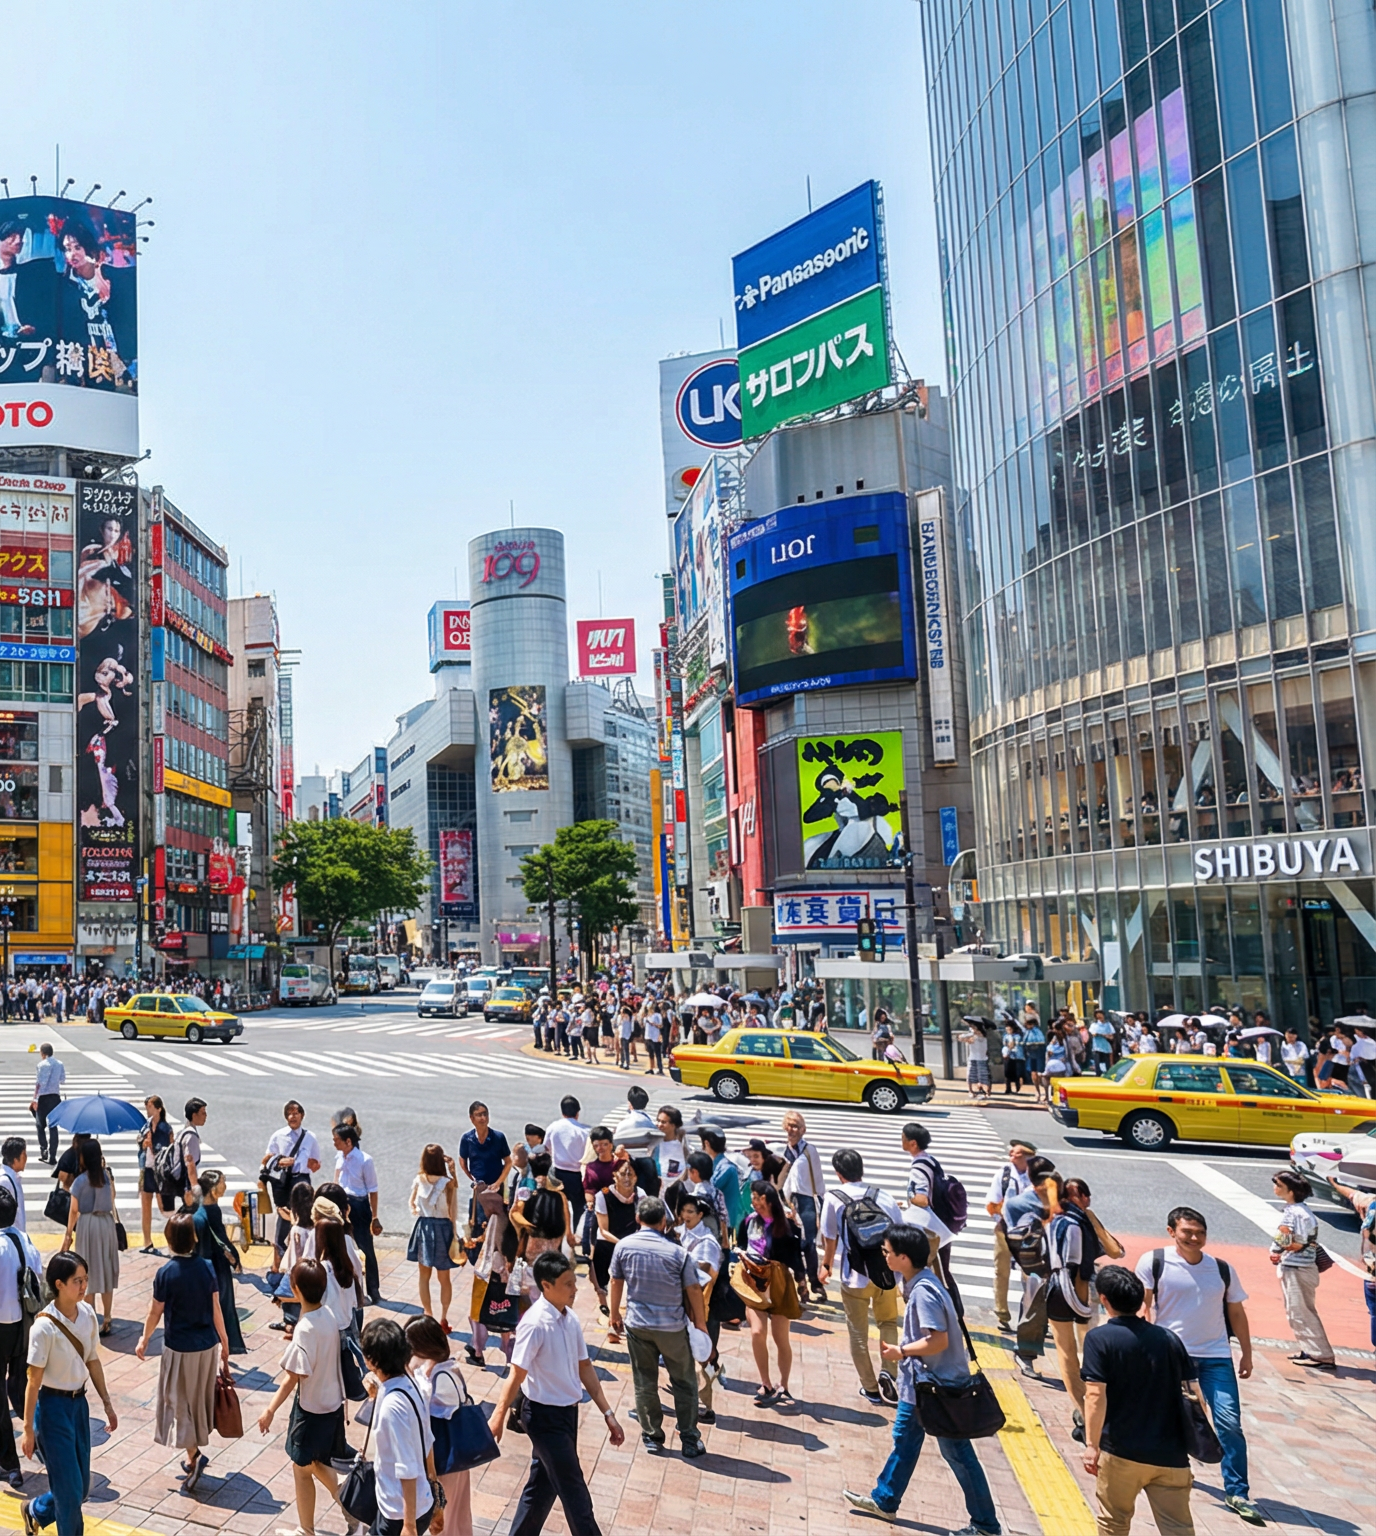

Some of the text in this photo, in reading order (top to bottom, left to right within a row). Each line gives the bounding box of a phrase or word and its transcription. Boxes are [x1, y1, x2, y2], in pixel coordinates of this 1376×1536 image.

[746, 323, 874, 408] サロンパス
[481, 551, 541, 589] 109
[1194, 836, 1361, 880] SHIBUYA
